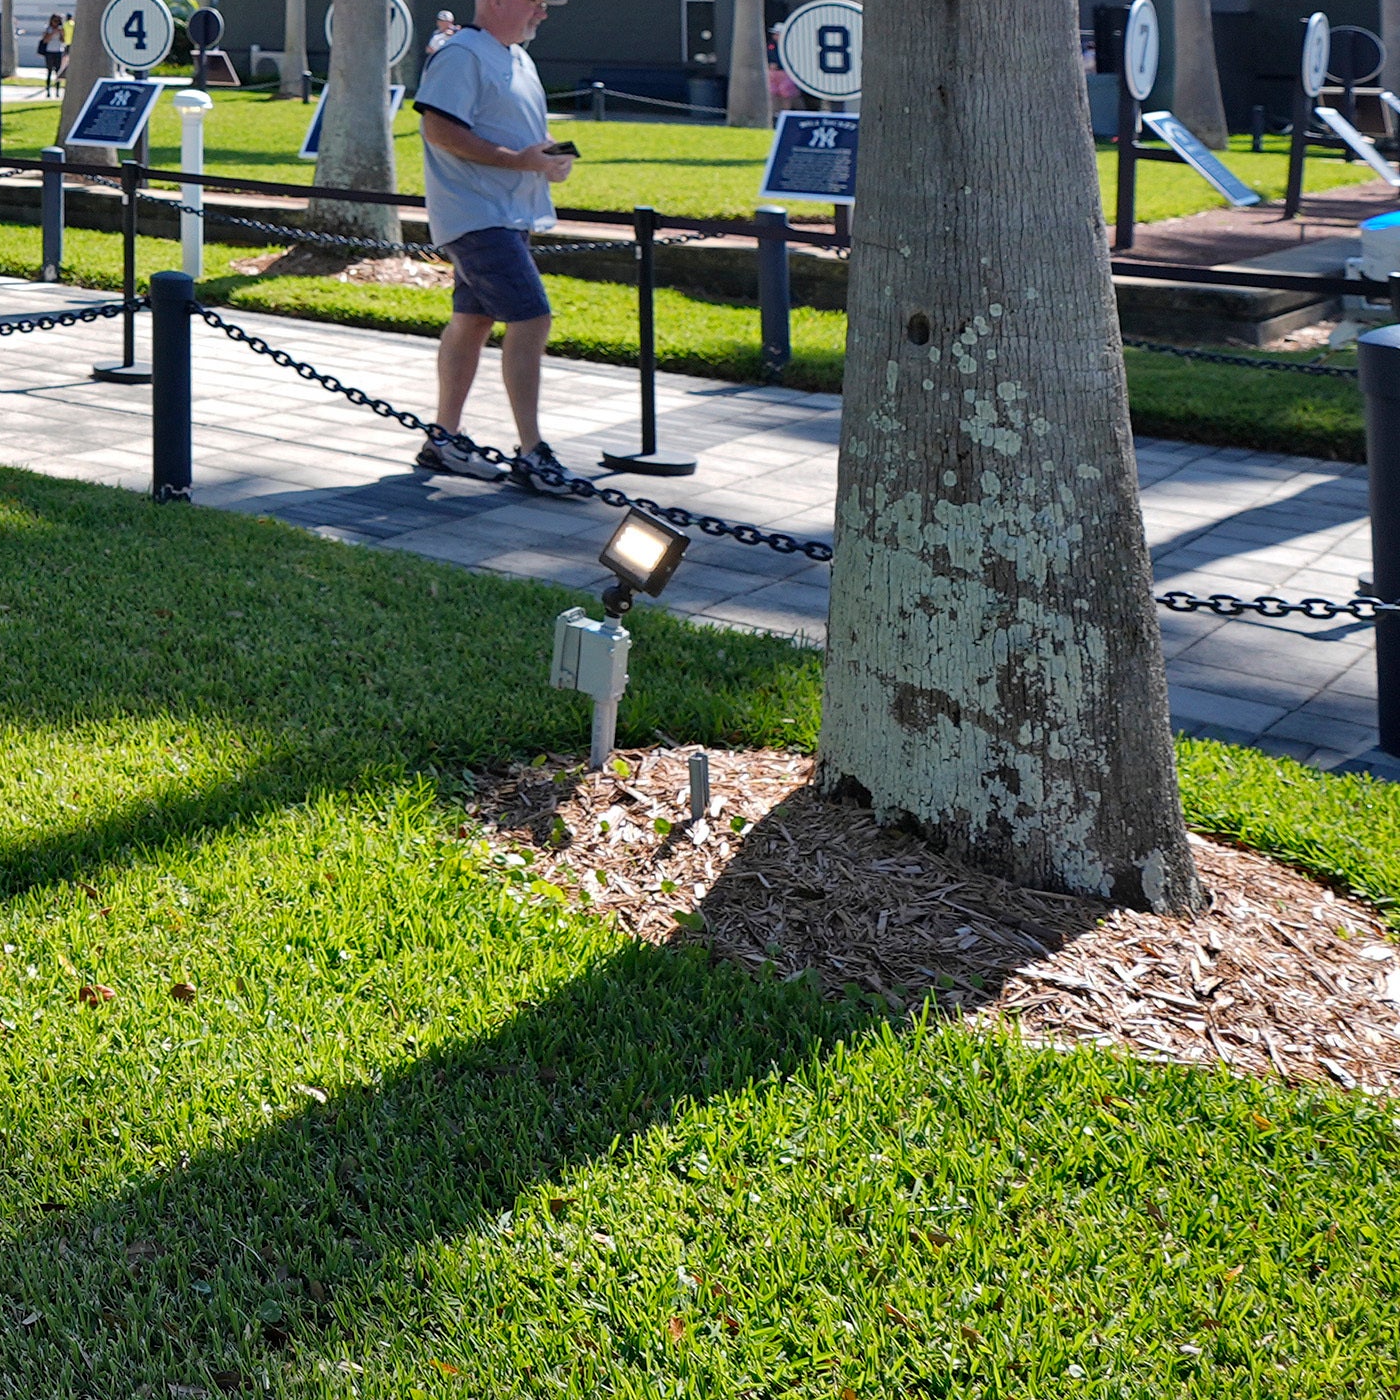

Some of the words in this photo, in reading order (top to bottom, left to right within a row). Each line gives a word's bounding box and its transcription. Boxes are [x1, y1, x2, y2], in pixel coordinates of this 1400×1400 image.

[124, 10, 146, 50] 4
[818, 25, 851, 74] 8
[1139, 24, 1150, 74] 7
